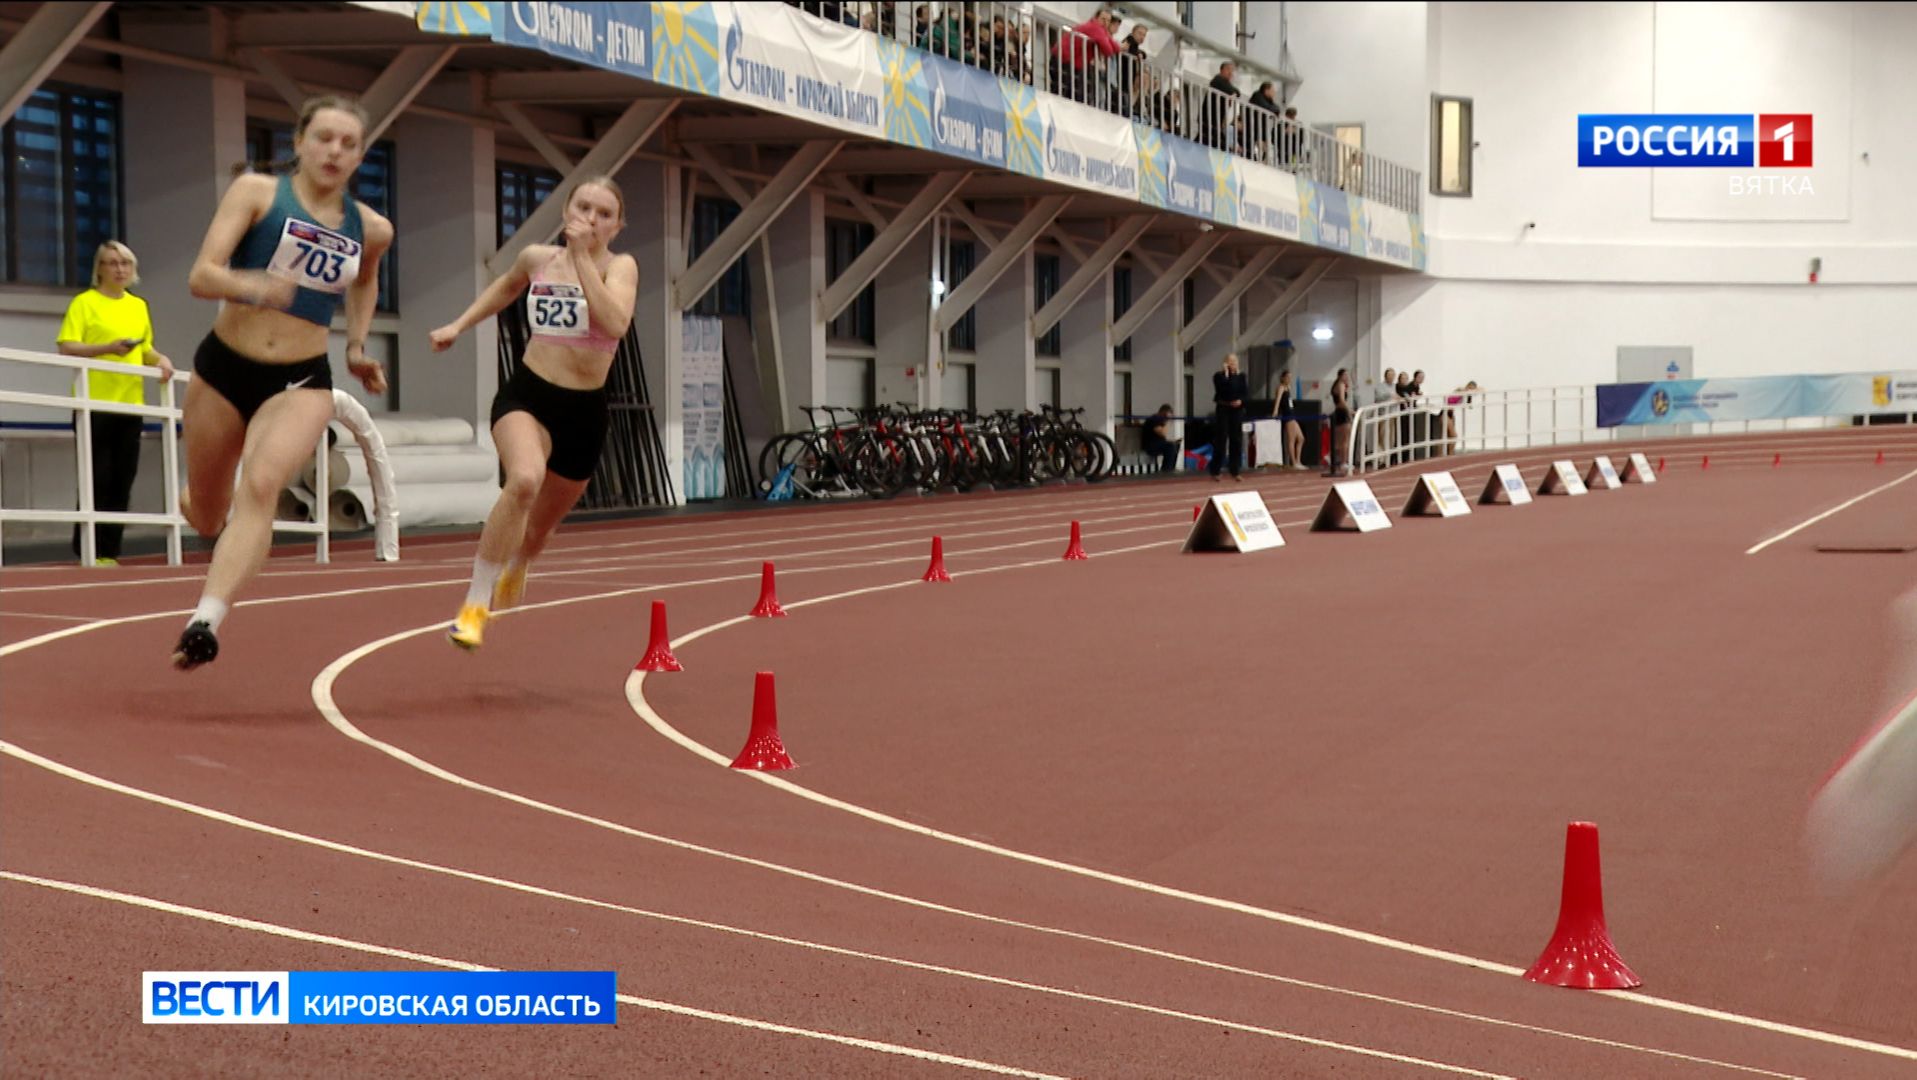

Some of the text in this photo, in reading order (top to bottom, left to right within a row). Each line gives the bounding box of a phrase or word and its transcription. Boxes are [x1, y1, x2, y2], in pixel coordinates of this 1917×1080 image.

[607, 19, 645, 66] ДЕТЯМ
[288, 241, 346, 283] 703
[535, 298, 578, 328] 523
